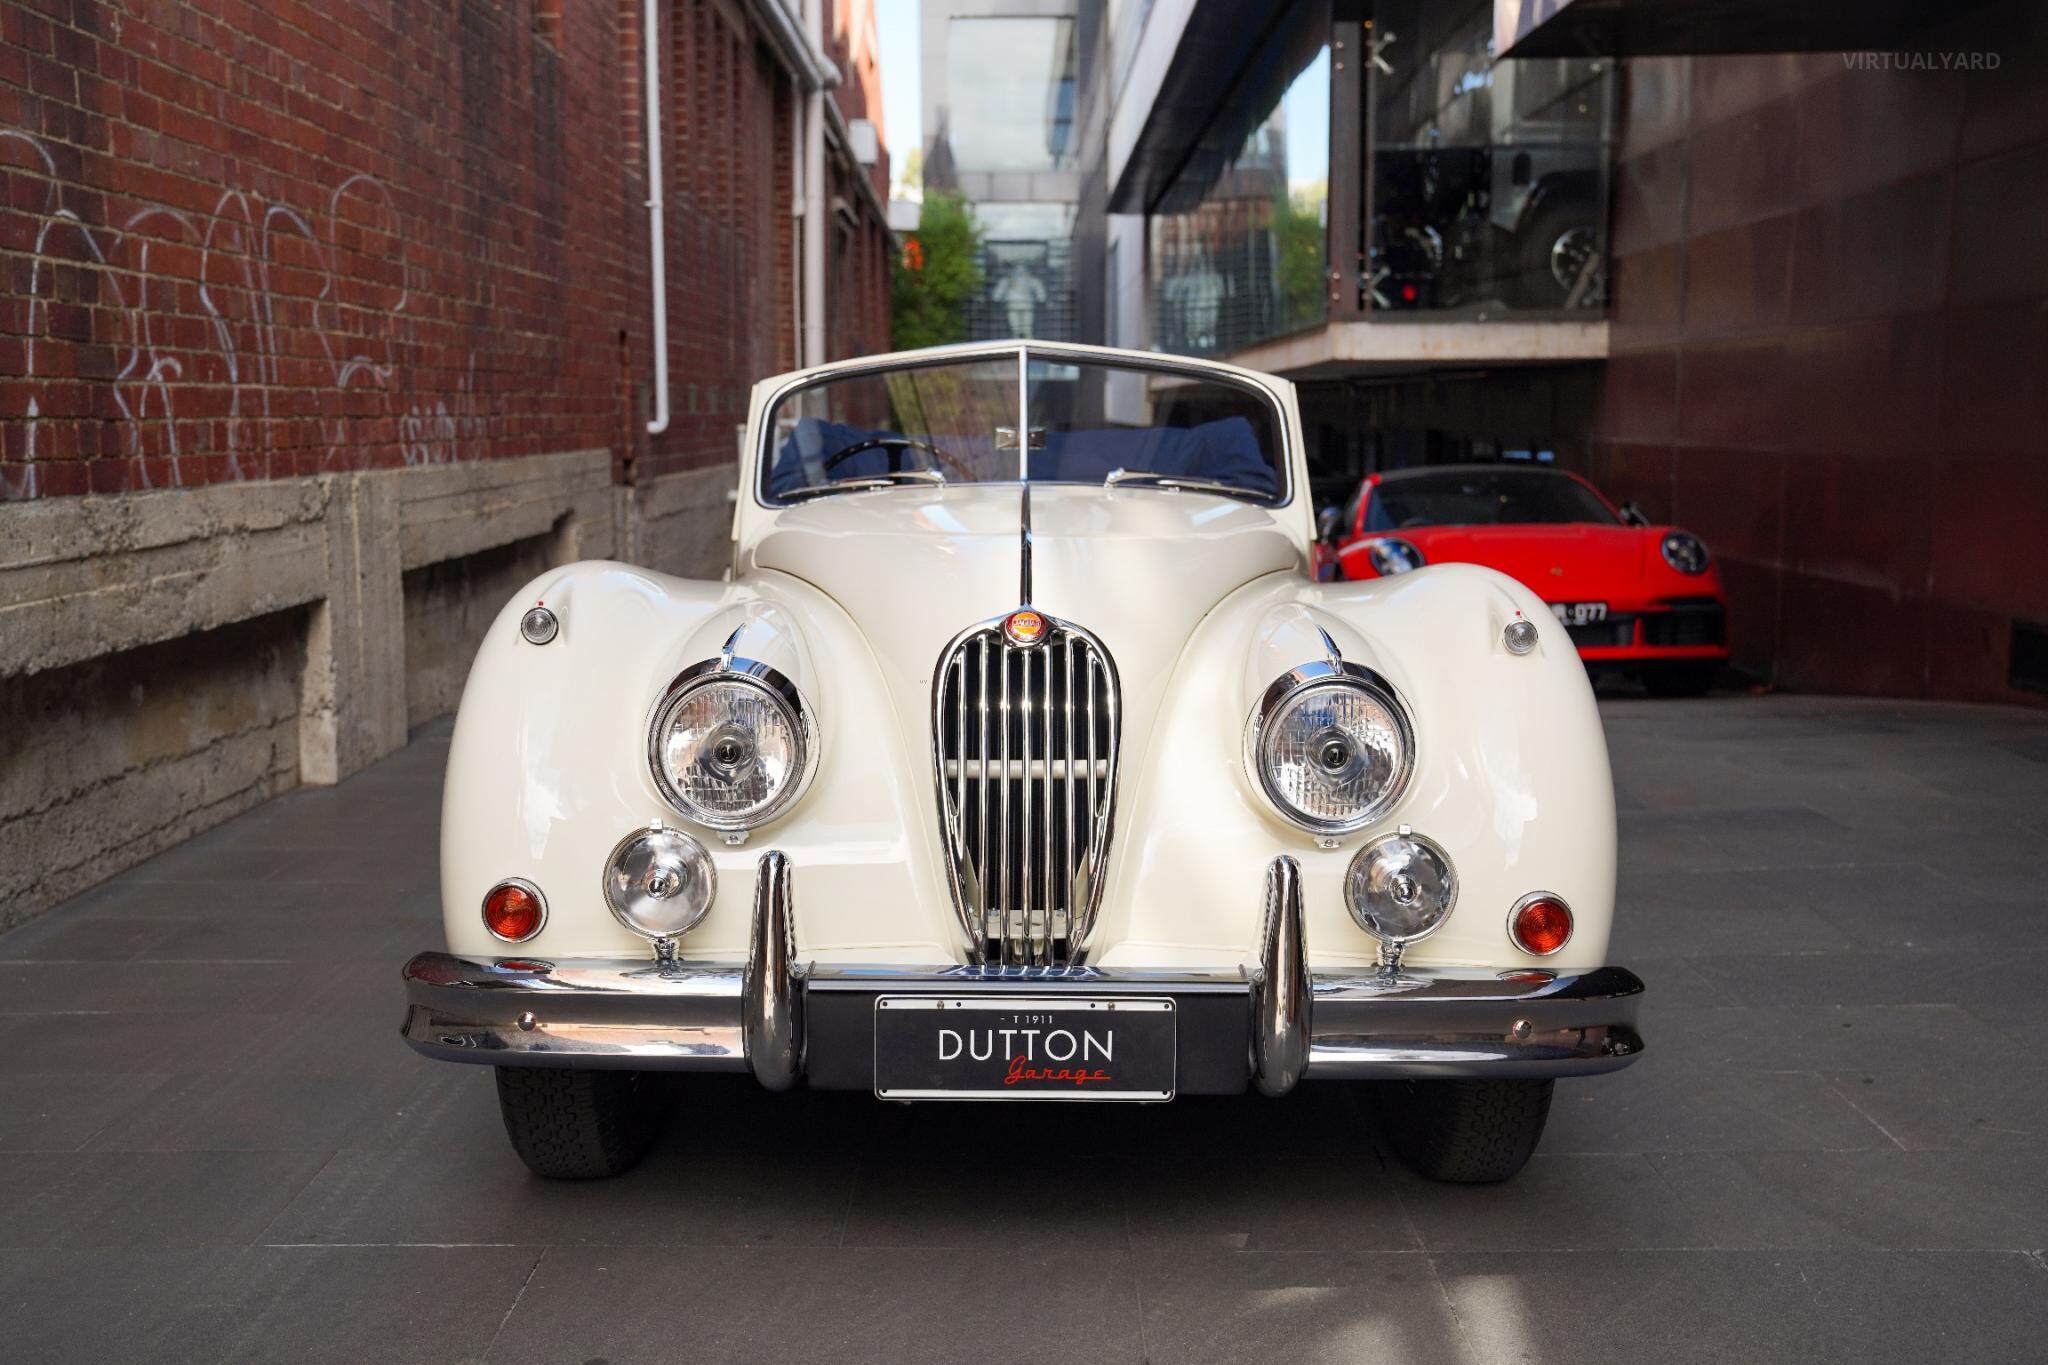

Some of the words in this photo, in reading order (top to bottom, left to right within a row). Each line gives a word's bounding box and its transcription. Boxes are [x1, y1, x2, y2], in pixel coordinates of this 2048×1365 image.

[1025, 1015, 1053, 1024] 1911
[938, 1029, 1113, 1062] DUTTON
[1004, 1056, 1111, 1085] Garage
